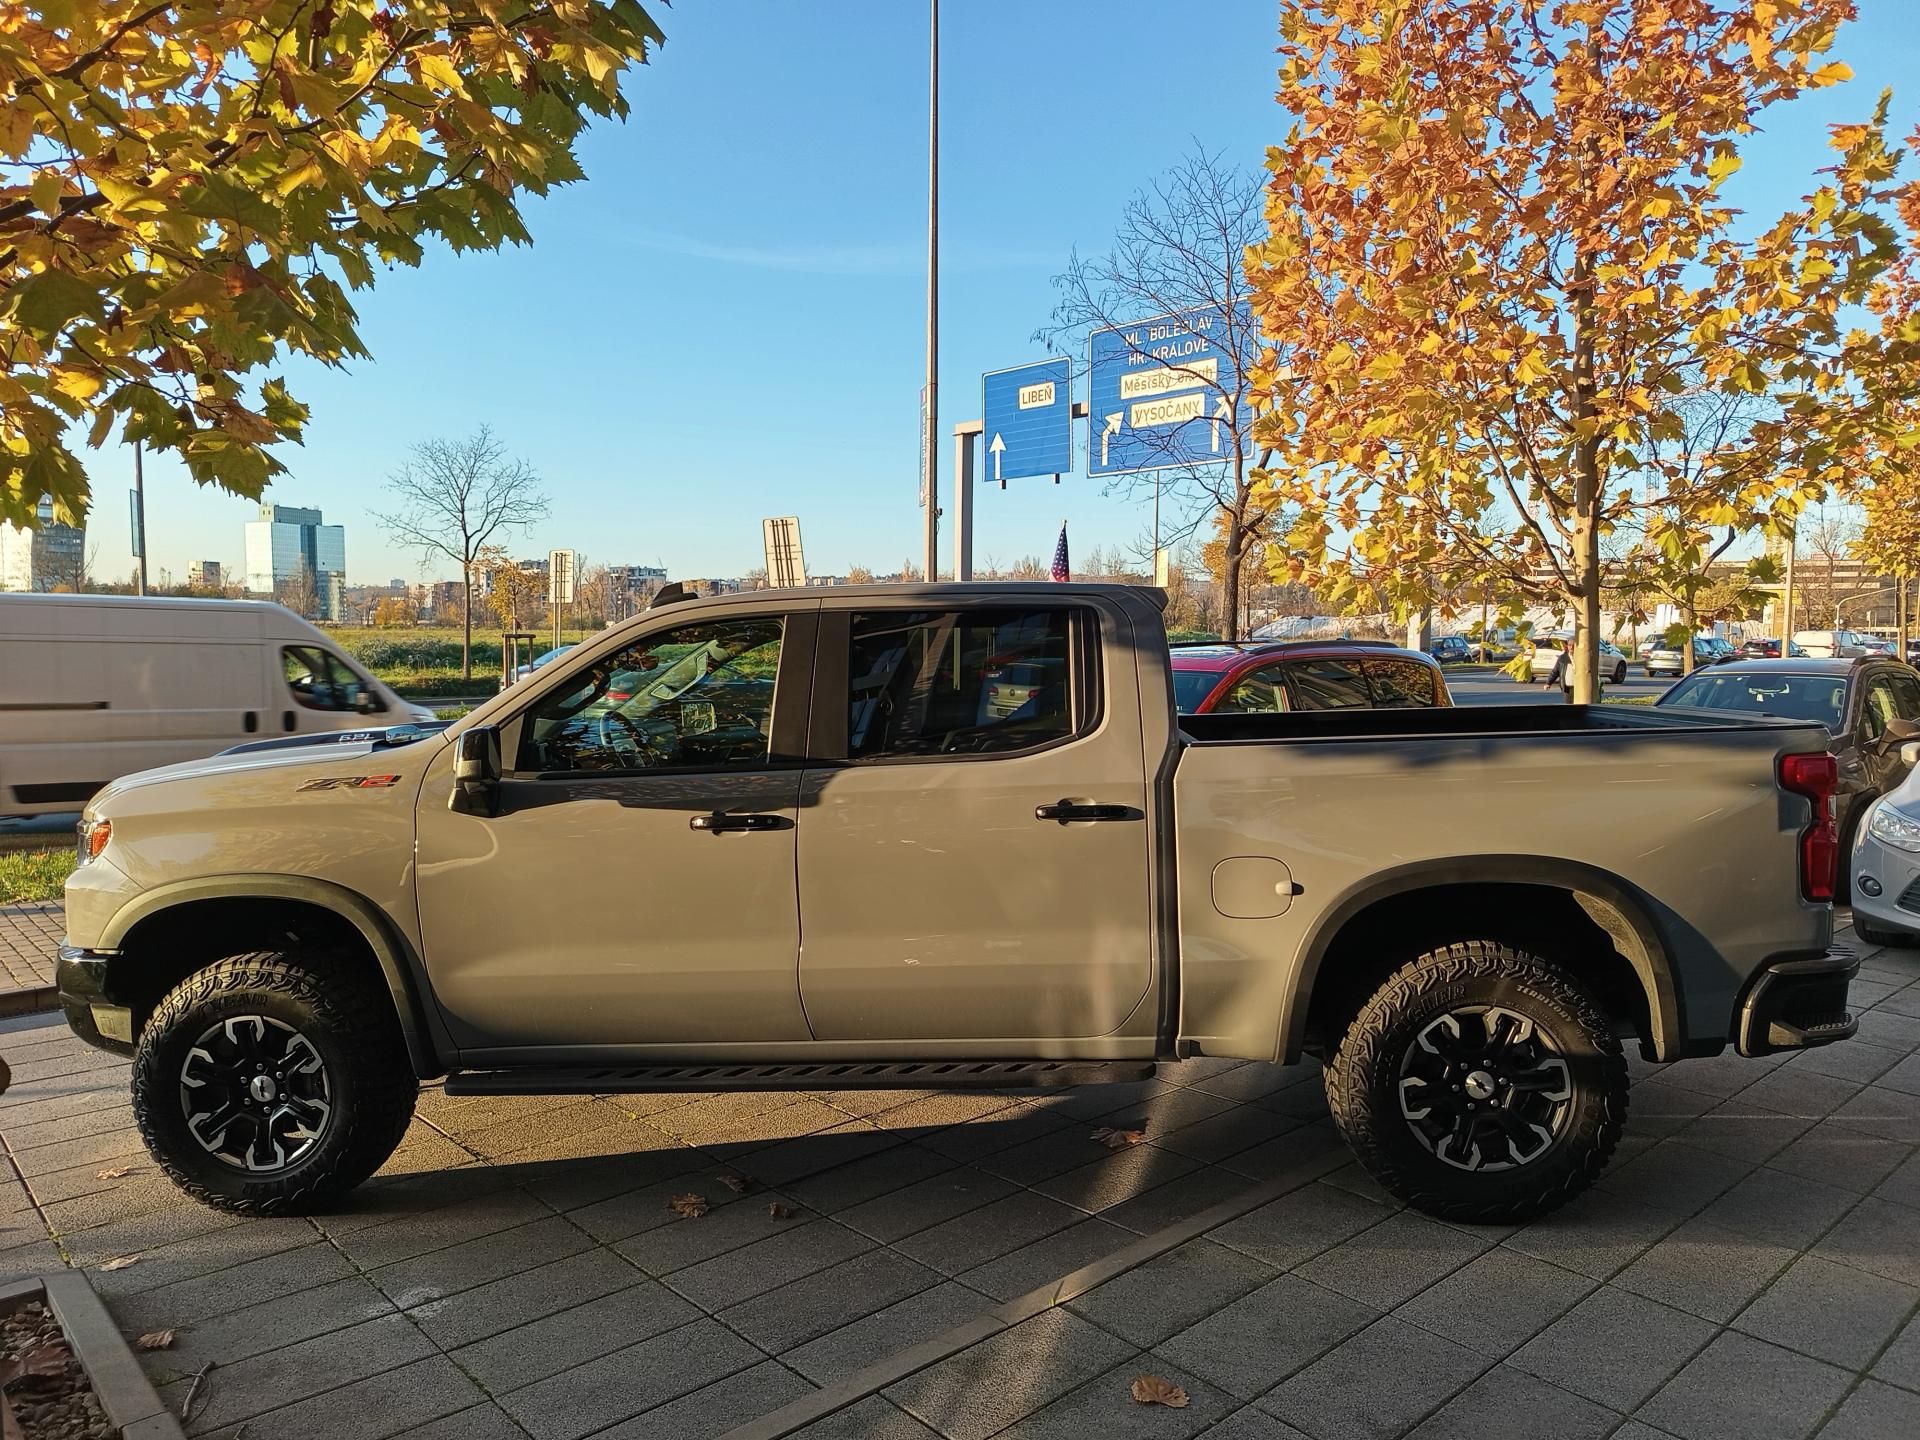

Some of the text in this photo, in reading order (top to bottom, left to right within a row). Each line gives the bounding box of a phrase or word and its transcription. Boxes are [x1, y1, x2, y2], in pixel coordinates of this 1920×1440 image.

[1125, 316, 1213, 346] ML. BOLESLAV
[1022, 385, 1052, 404] LIBEŇ
[1134, 400, 1200, 422] VYSOČANY
[296, 774, 402, 792] ZR2
[1516, 984, 1572, 1022] TERRITORY
